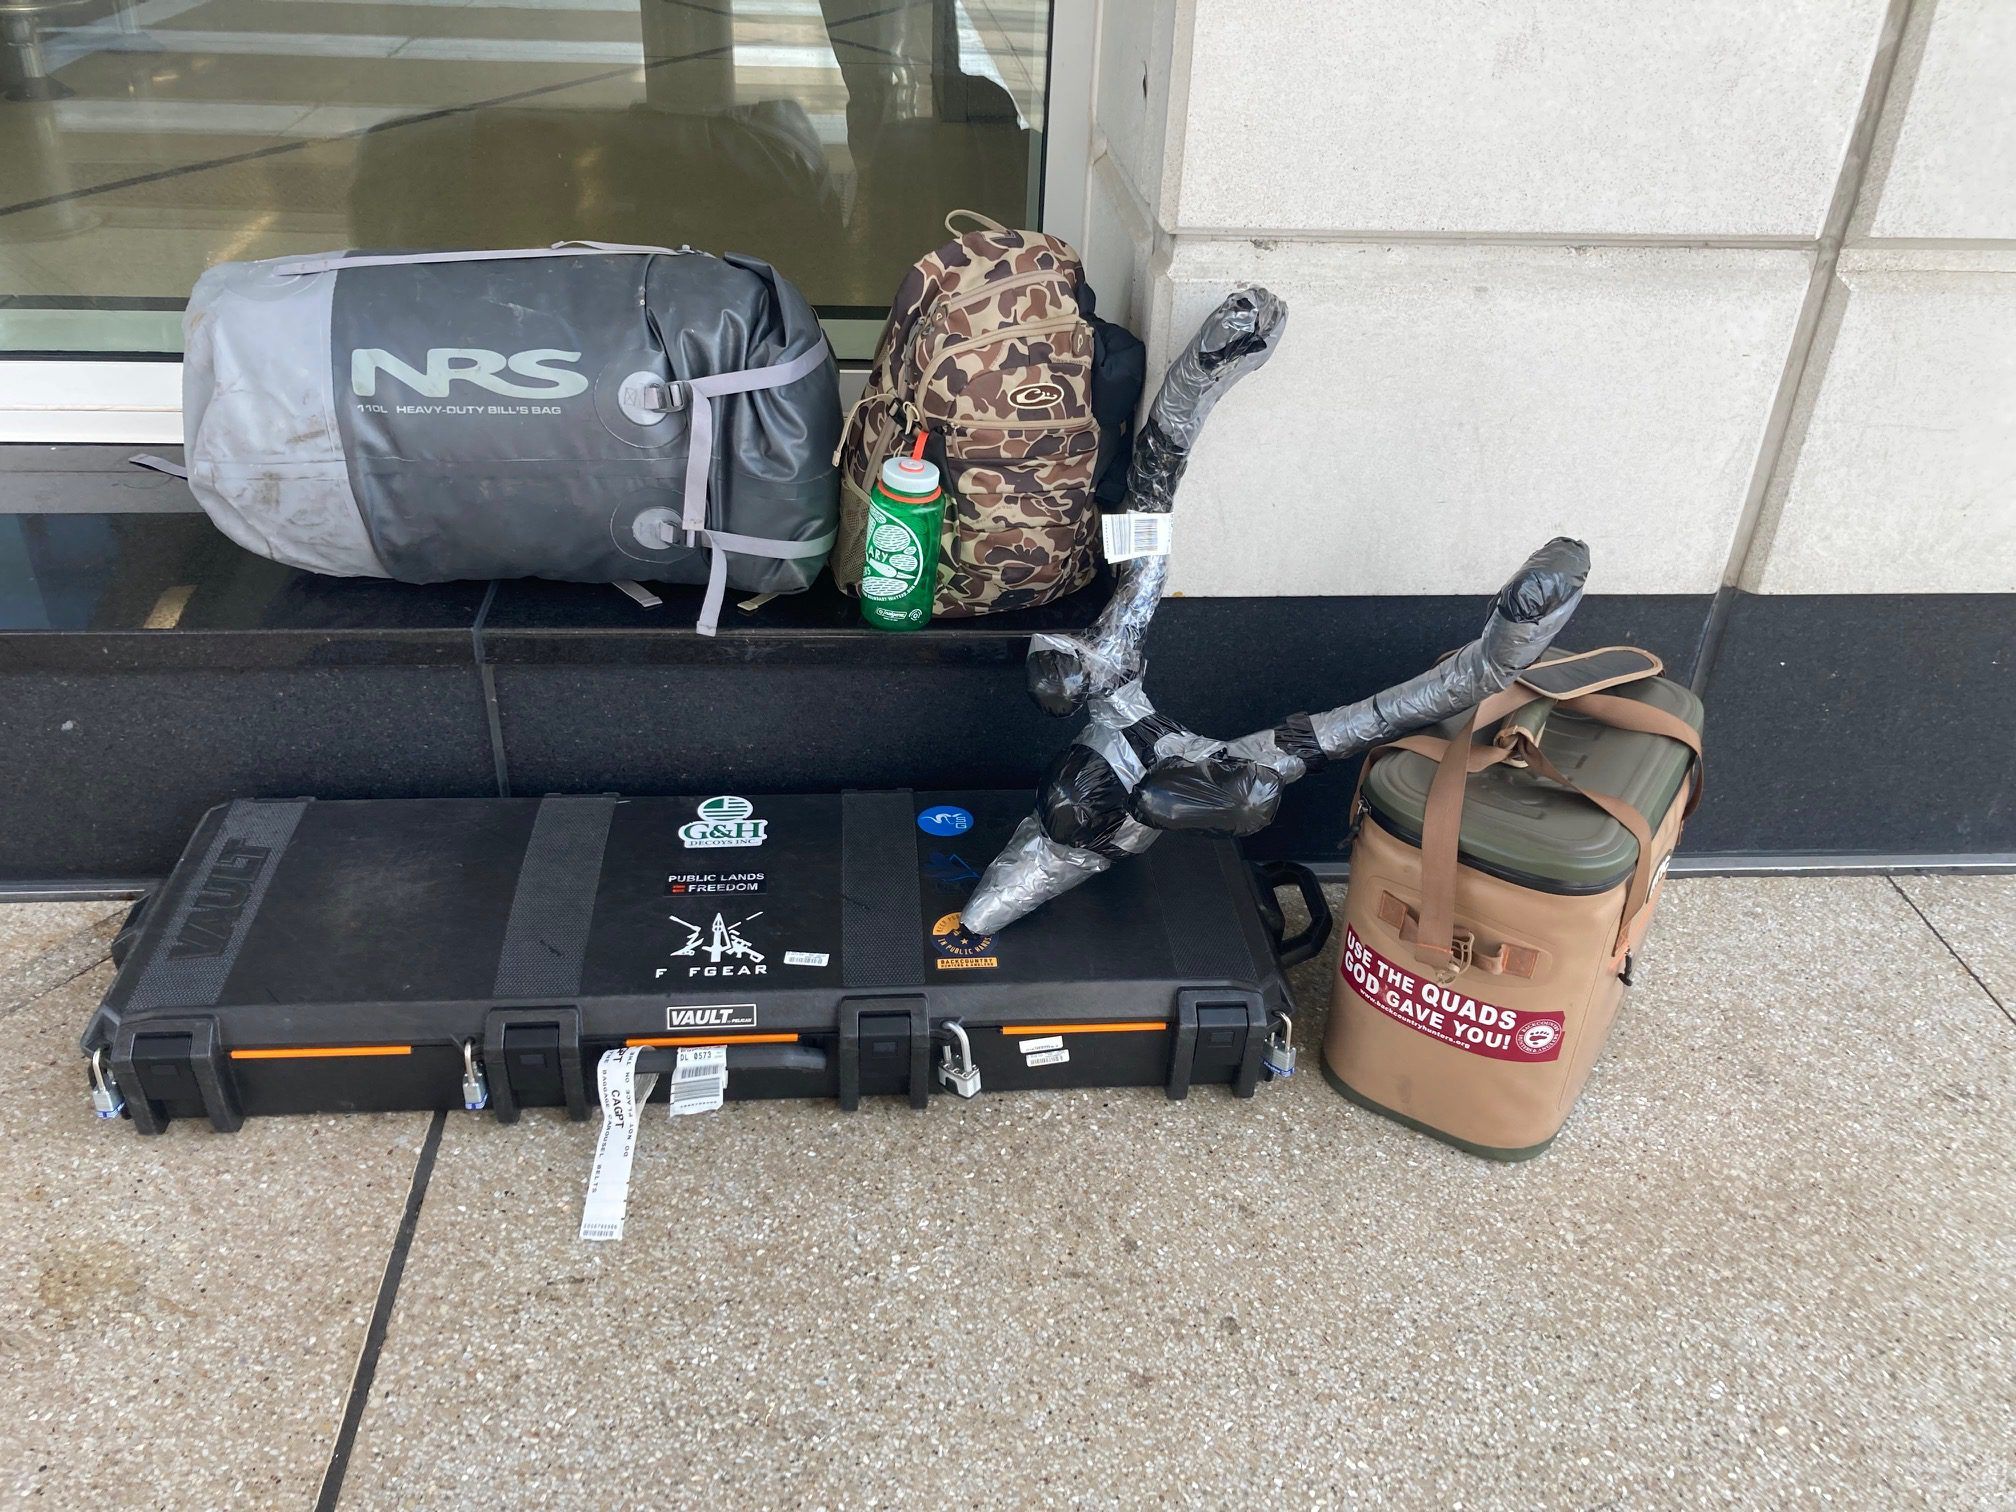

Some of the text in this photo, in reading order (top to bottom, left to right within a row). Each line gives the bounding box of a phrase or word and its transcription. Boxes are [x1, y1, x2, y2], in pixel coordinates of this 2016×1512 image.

[352, 348, 588, 399] NRS
[357, 404, 562, 415] 110L HEAVY-DUTY BILL'S BAG
[684, 822, 763, 840] G&H
[668, 873, 765, 883] PUBLIC LANDS
[688, 883, 758, 892] FREEDOM
[945, 944, 973, 955] PUBLIC
[1347, 931, 1518, 1030] USE THE QUADS
[1345, 951, 1512, 1050] GOD GAVE YOU!
[671, 1008, 734, 1026] VAULT
[1360, 988, 1471, 1050] www.backcountryhunters.org
[680, 1053, 689, 1061] DL
[693, 1051, 712, 1060] 0573
[611, 1089, 625, 1128] CAGPT
[625, 1089, 633, 1118] PLACE
[599, 1114, 612, 1158] CAROUSEL
[592, 1164, 602, 1193] BELTS
